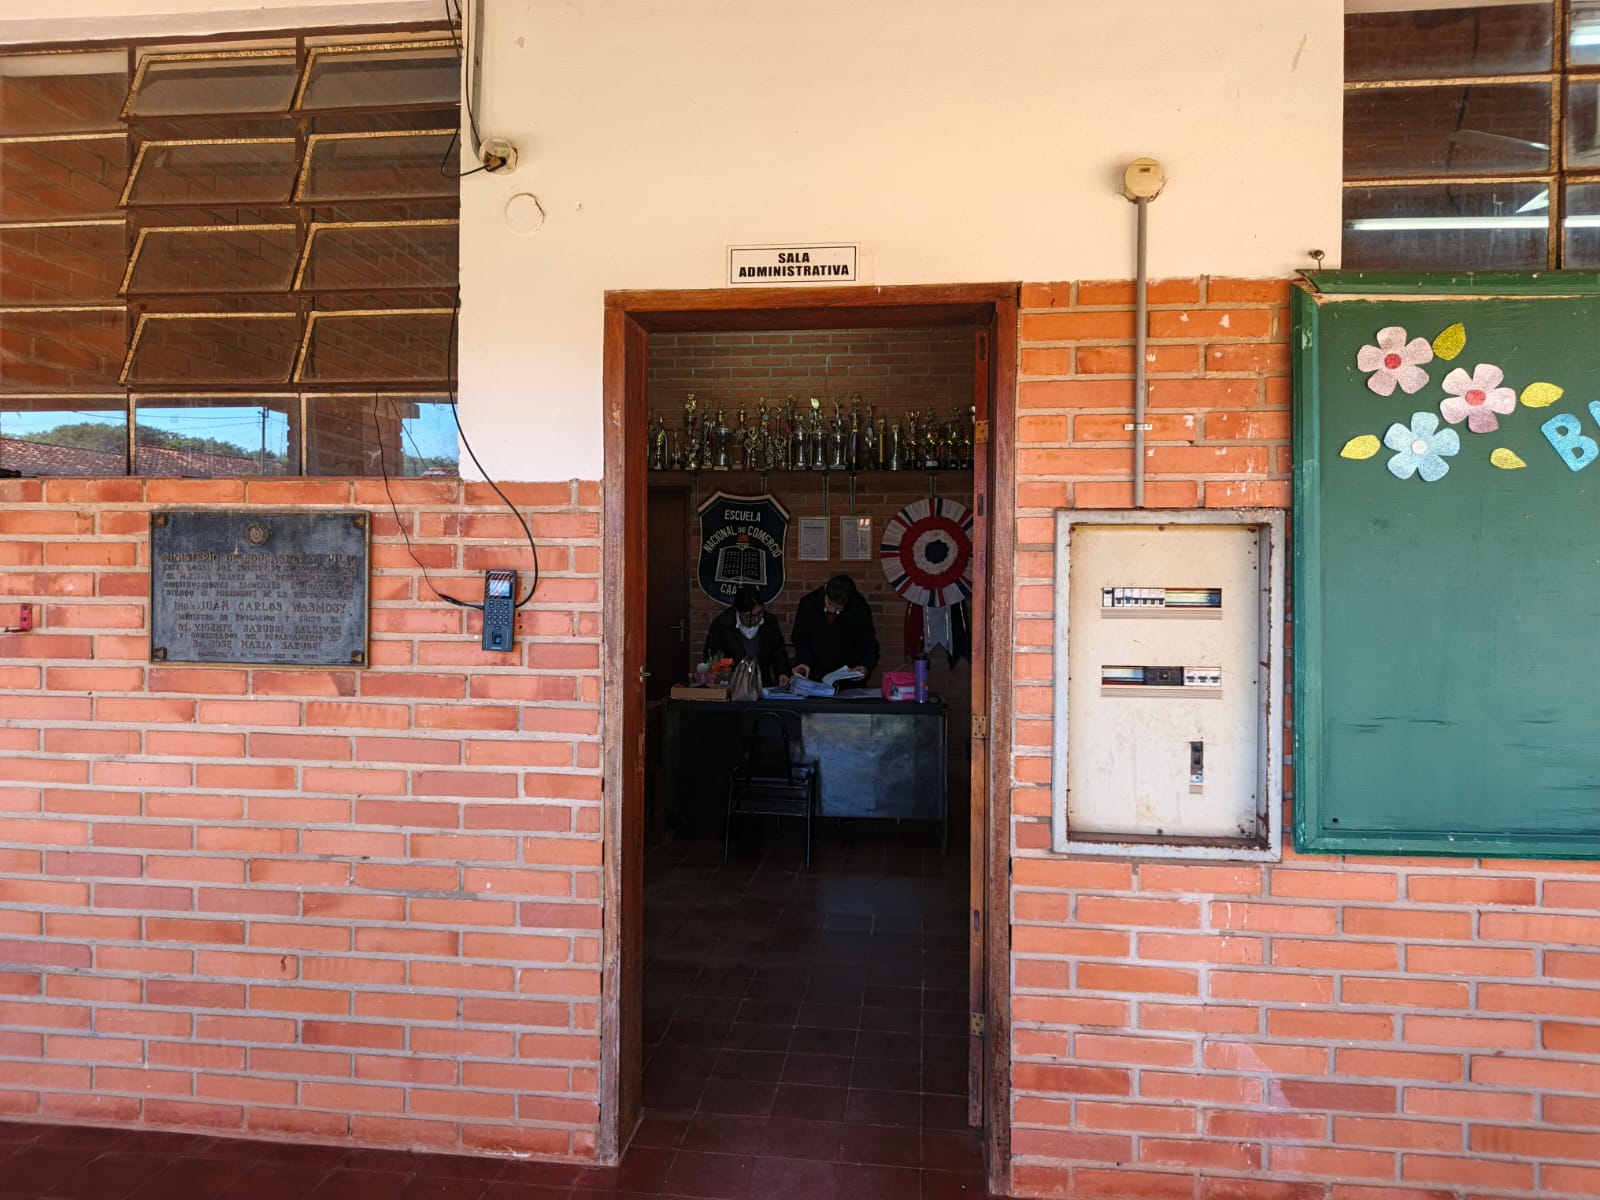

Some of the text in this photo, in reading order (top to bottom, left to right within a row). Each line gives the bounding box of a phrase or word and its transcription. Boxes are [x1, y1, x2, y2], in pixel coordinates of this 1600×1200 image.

[778, 252, 810, 264] SALA
[738, 264, 849, 277] ADMINISTRATIVA
[724, 509, 761, 522] ESCUELA
[703, 525, 738, 554] NACIONAL
[748, 525, 784, 558] COMERCIO
[200, 600, 229, 611] JUAN
[238, 602, 282, 613] CARLOS
[290, 603, 346, 614] WASMOSY
[241, 640, 272, 649] MARIA
